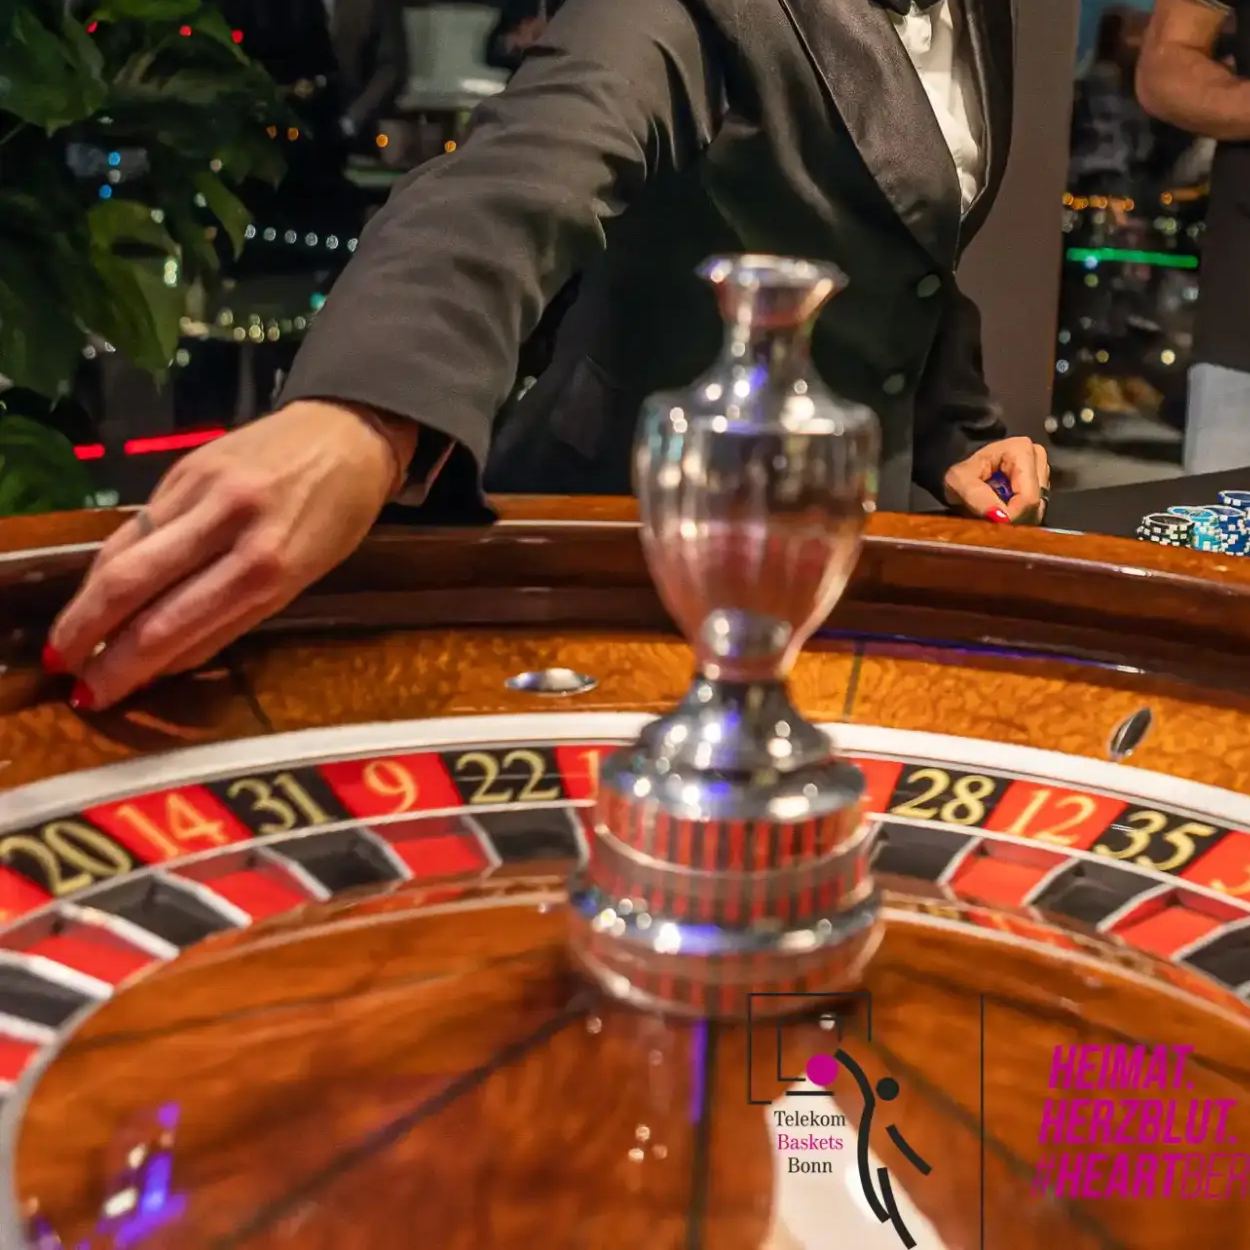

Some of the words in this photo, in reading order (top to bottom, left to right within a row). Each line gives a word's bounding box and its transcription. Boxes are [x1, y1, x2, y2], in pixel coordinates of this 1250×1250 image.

[228, 773, 332, 836] 31
[363, 760, 418, 813] 9
[455, 749, 560, 805] 22
[892, 767, 997, 827] 28
[117, 793, 228, 861] 14
[1003, 788, 1098, 845] 12
[1094, 809, 1218, 872] 35
[0, 820, 132, 896] 20
